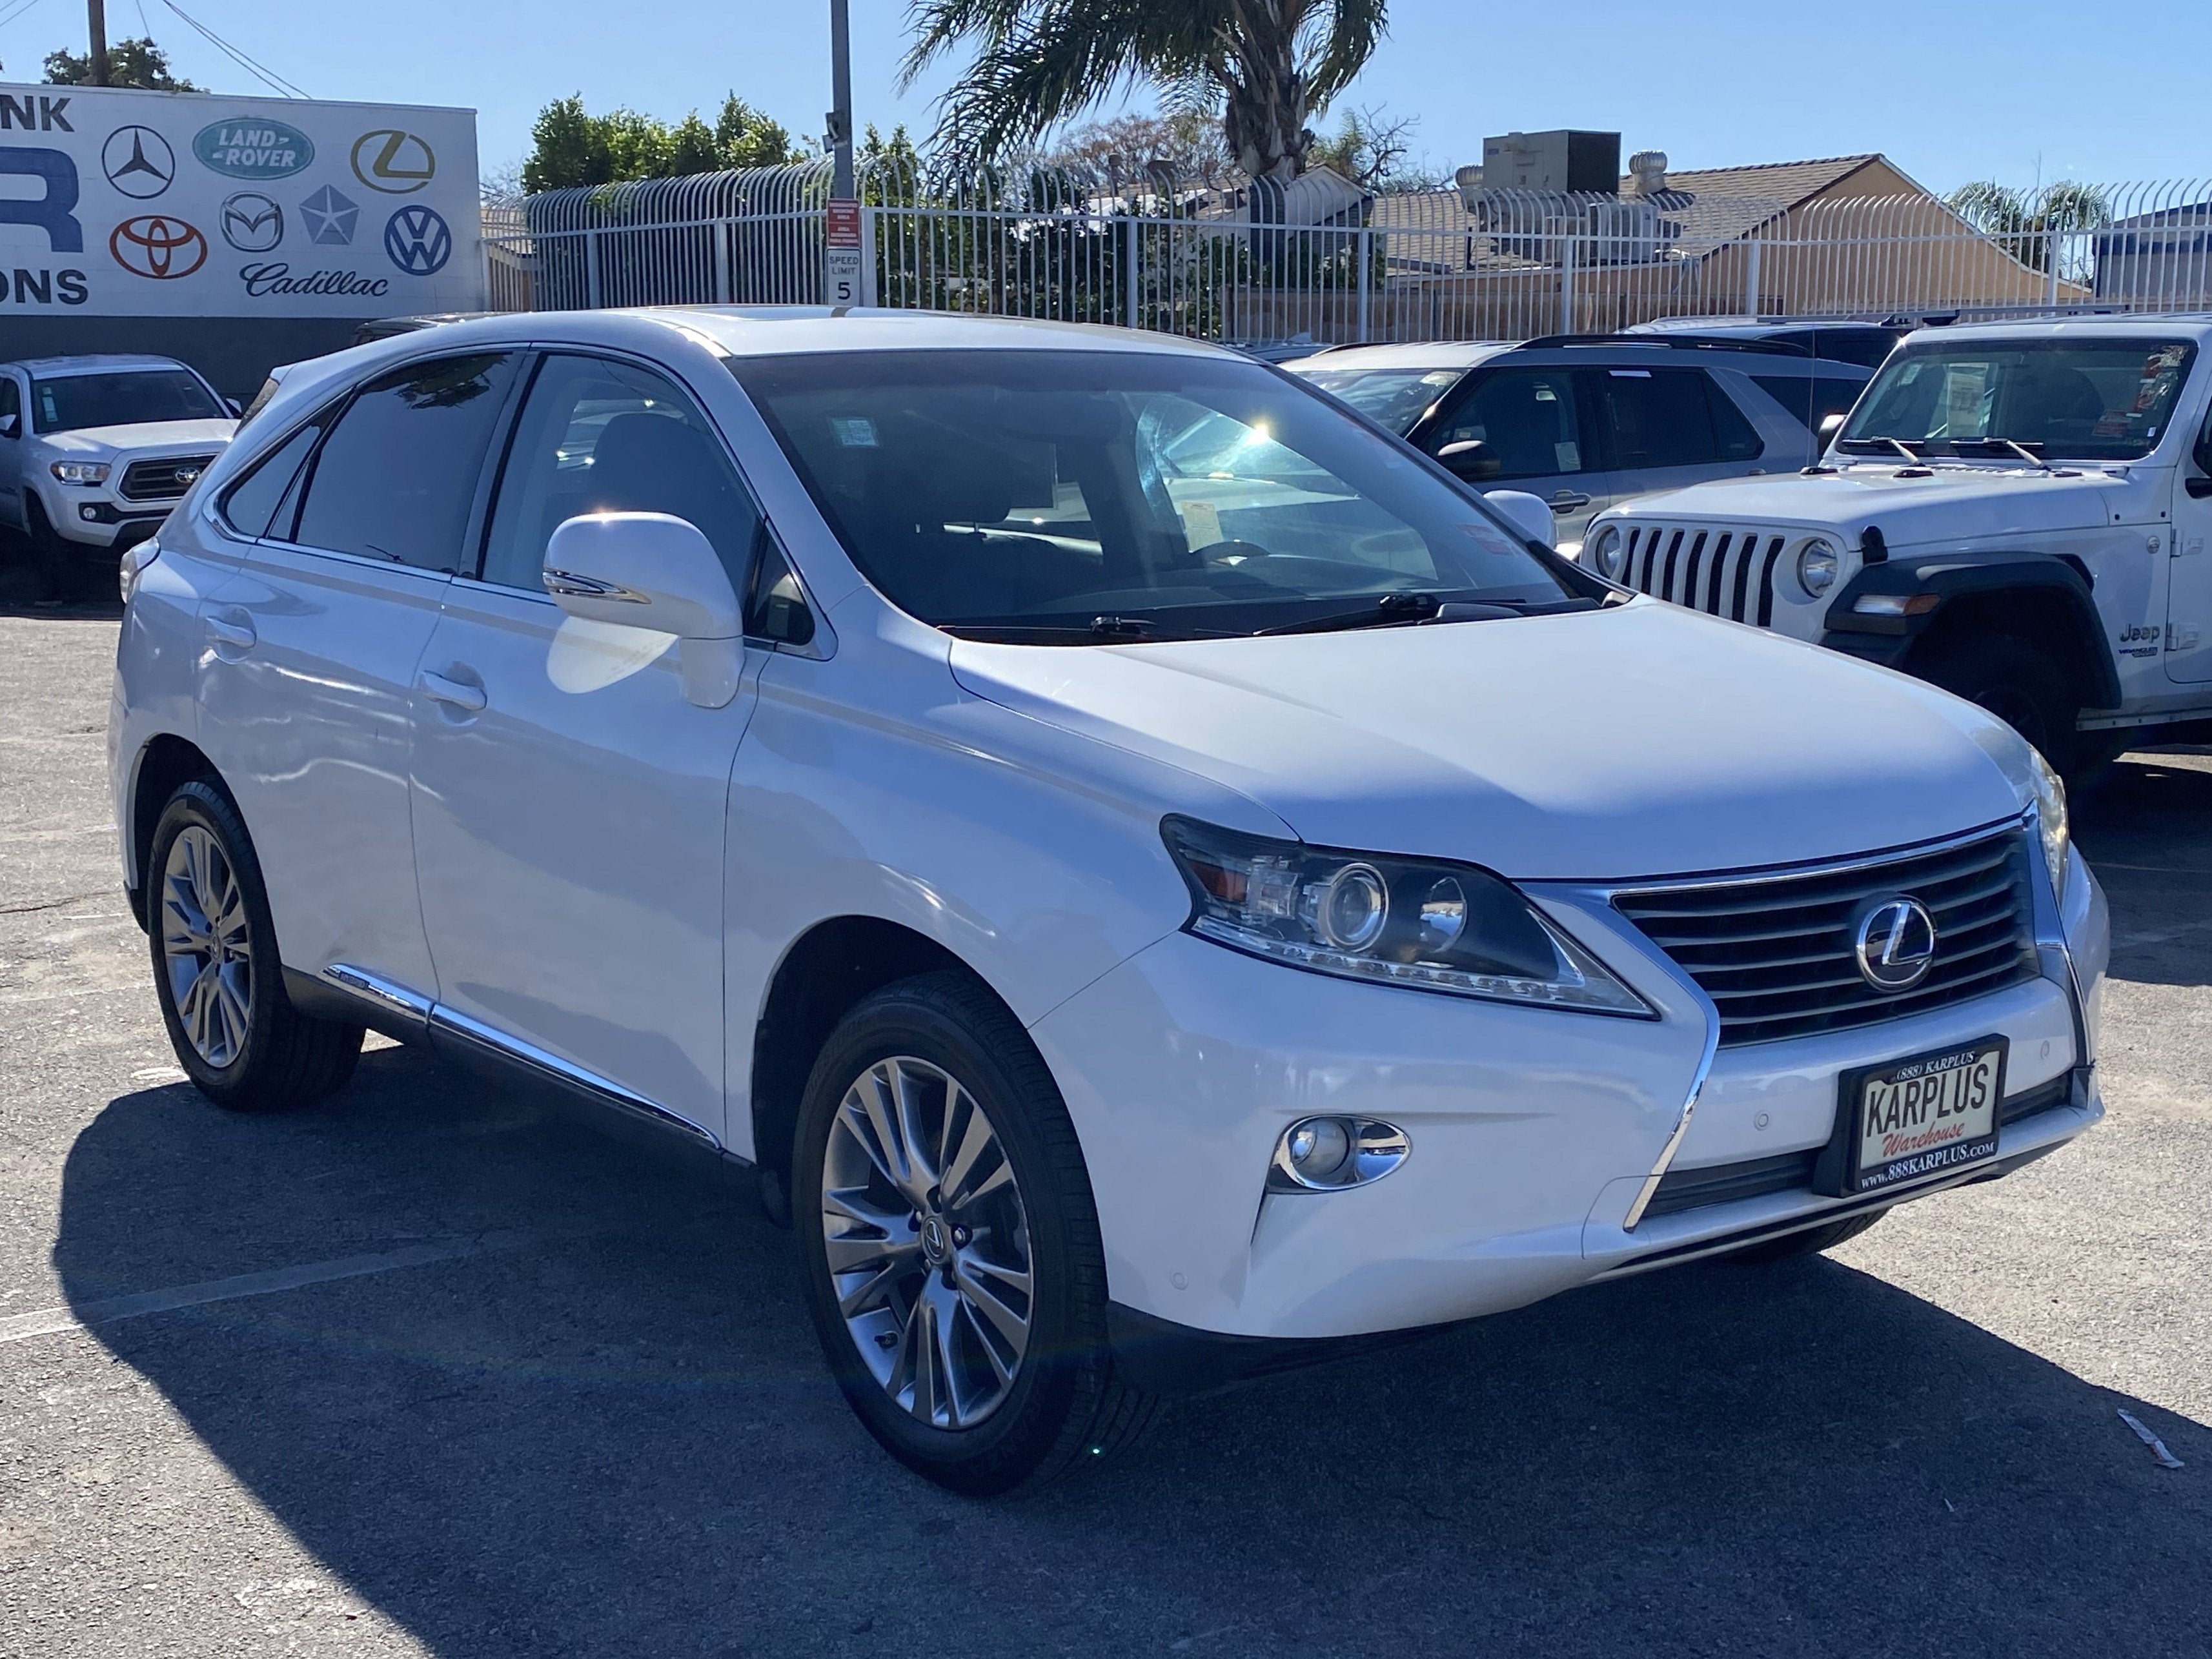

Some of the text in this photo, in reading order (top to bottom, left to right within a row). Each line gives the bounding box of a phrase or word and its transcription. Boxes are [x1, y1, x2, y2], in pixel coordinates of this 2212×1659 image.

[0, 95, 75, 132] NK
[218, 128, 276, 147] LAND
[225, 148, 296, 167] ROVER
[829, 256, 859, 265] SPEED
[832, 267, 856, 275] LIMIT
[239, 263, 389, 296] Cadillac
[838, 281, 851, 300] 5
[2119, 623, 2160, 644] Jeep
[1925, 1051, 1976, 1074] KARPLUS
[1866, 1063, 1989, 1137] KARPLUS
[1882, 1121, 1965, 1157] Warehouse
